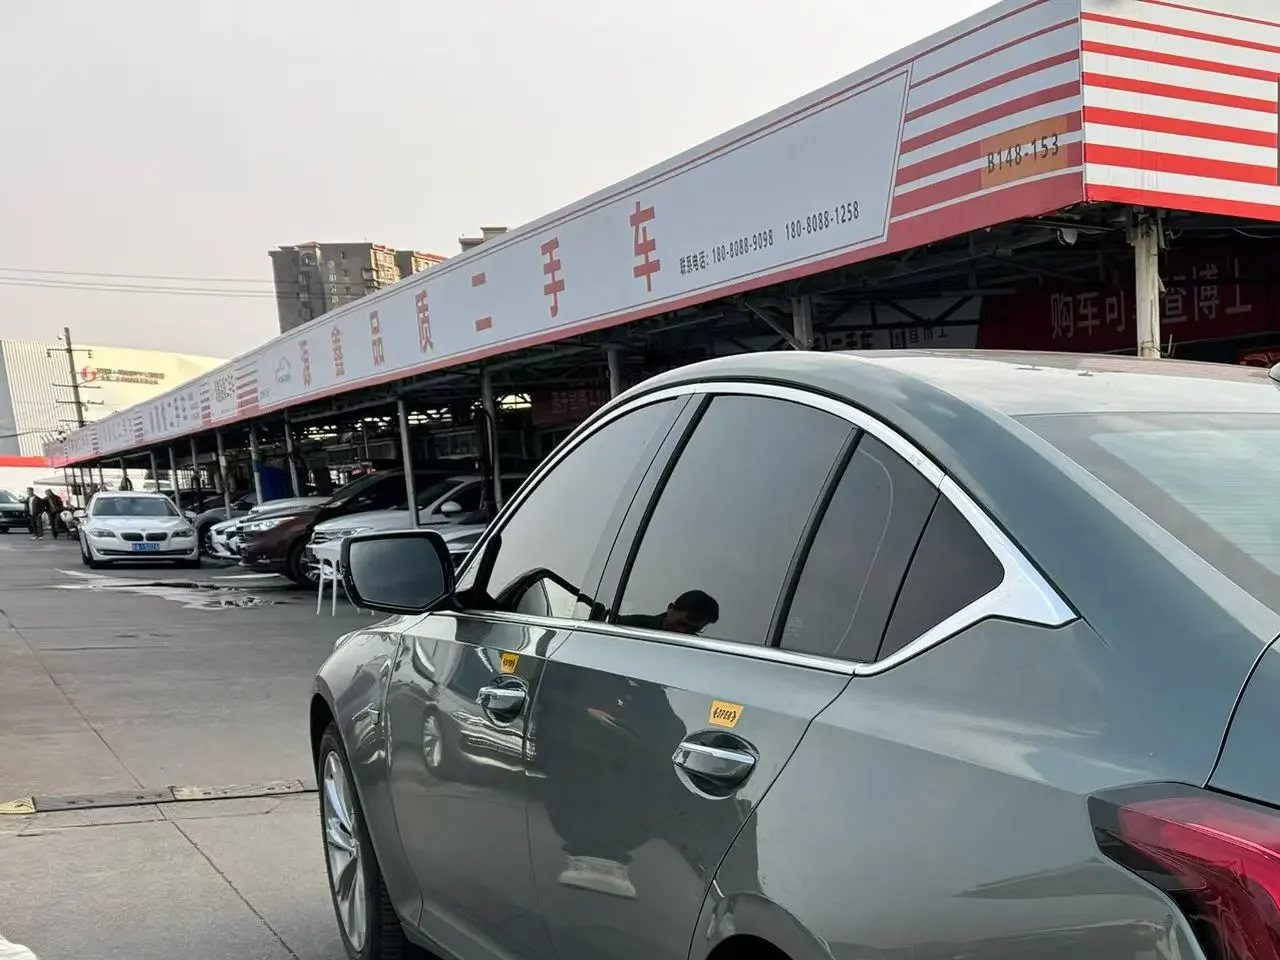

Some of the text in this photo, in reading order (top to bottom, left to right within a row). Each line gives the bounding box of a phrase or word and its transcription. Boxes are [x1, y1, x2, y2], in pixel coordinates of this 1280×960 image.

[987, 133, 1059, 173] B148-153
[712, 229, 774, 263] 180-8088-9098
[785, 200, 860, 240] 180-8088-1258
[1050, 256, 1252, 339] 购车可查博士
